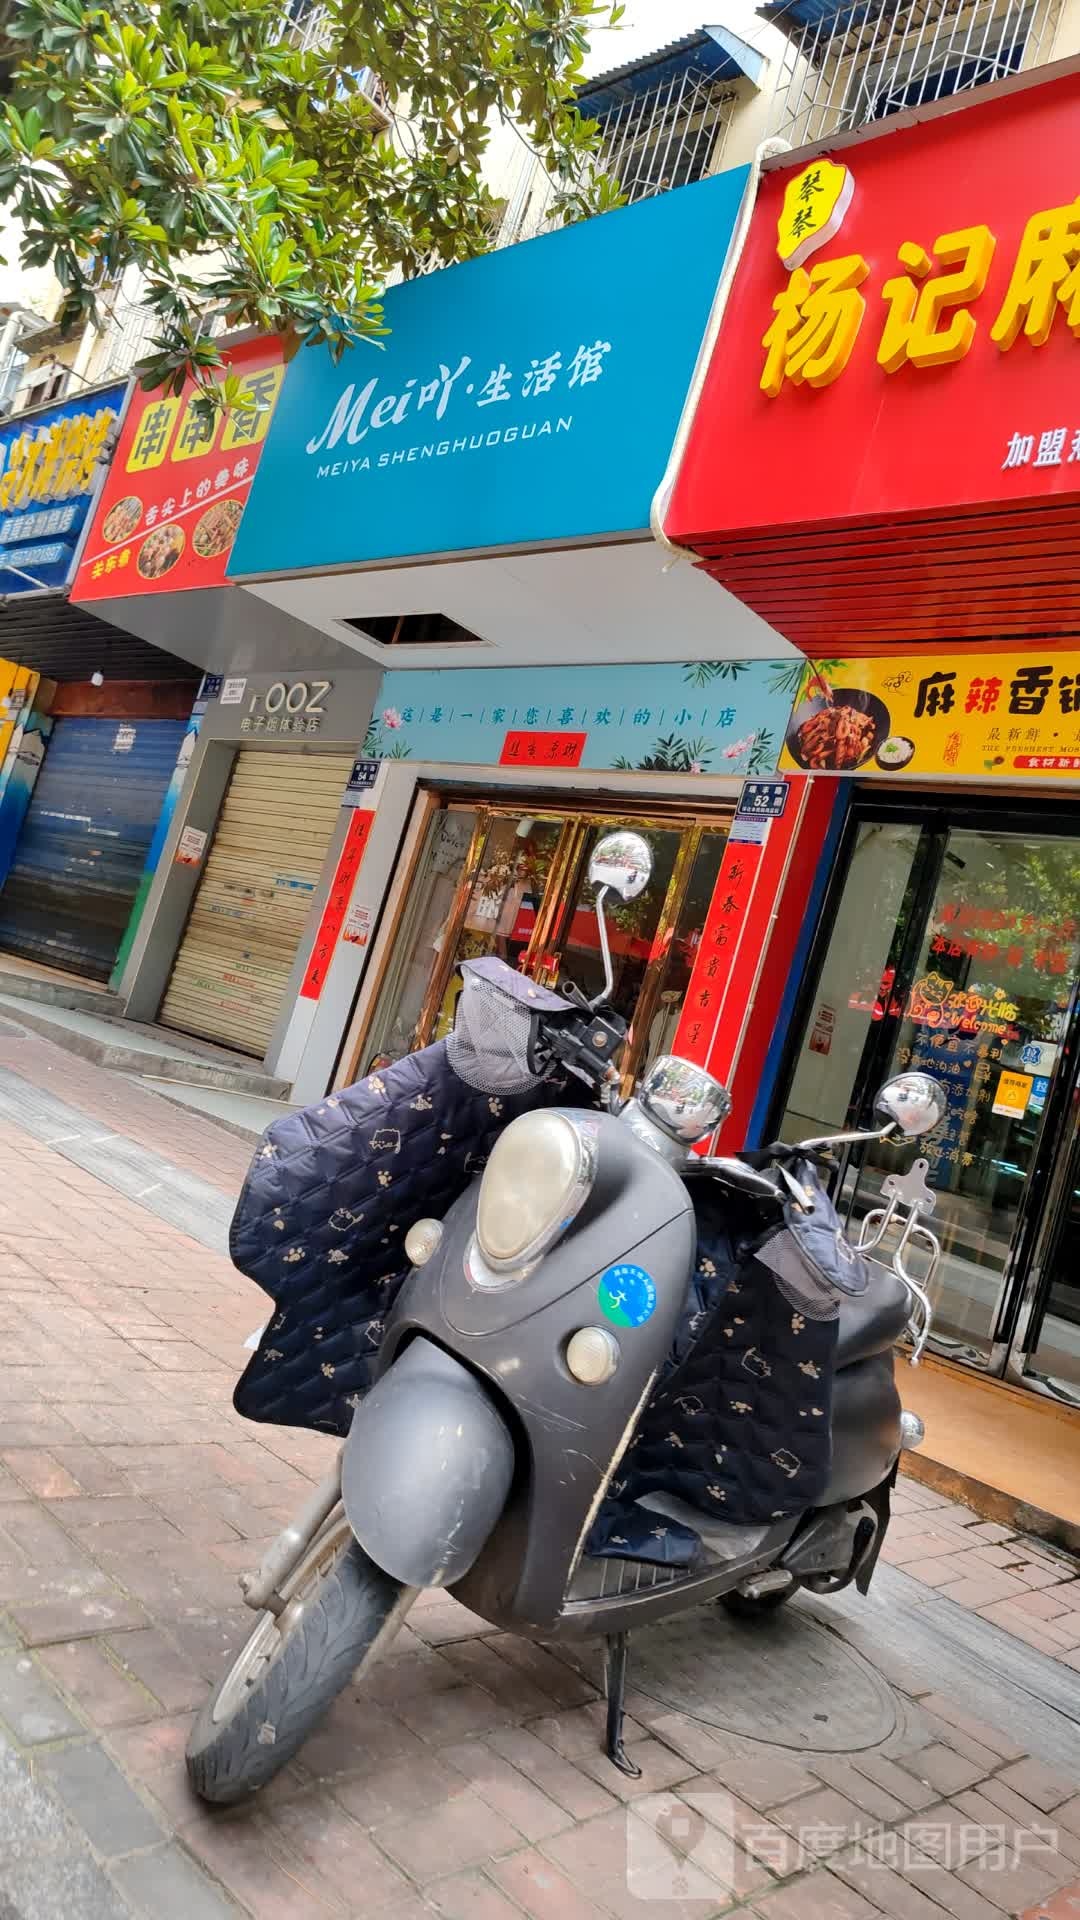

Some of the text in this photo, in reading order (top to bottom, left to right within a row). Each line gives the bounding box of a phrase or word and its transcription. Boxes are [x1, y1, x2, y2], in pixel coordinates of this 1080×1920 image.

[316, 416, 573, 479] MEIYA SHENGHUOGUAN
[240, 716, 321, 733] 电子烟体验店
[754, 795, 769, 807] 52
